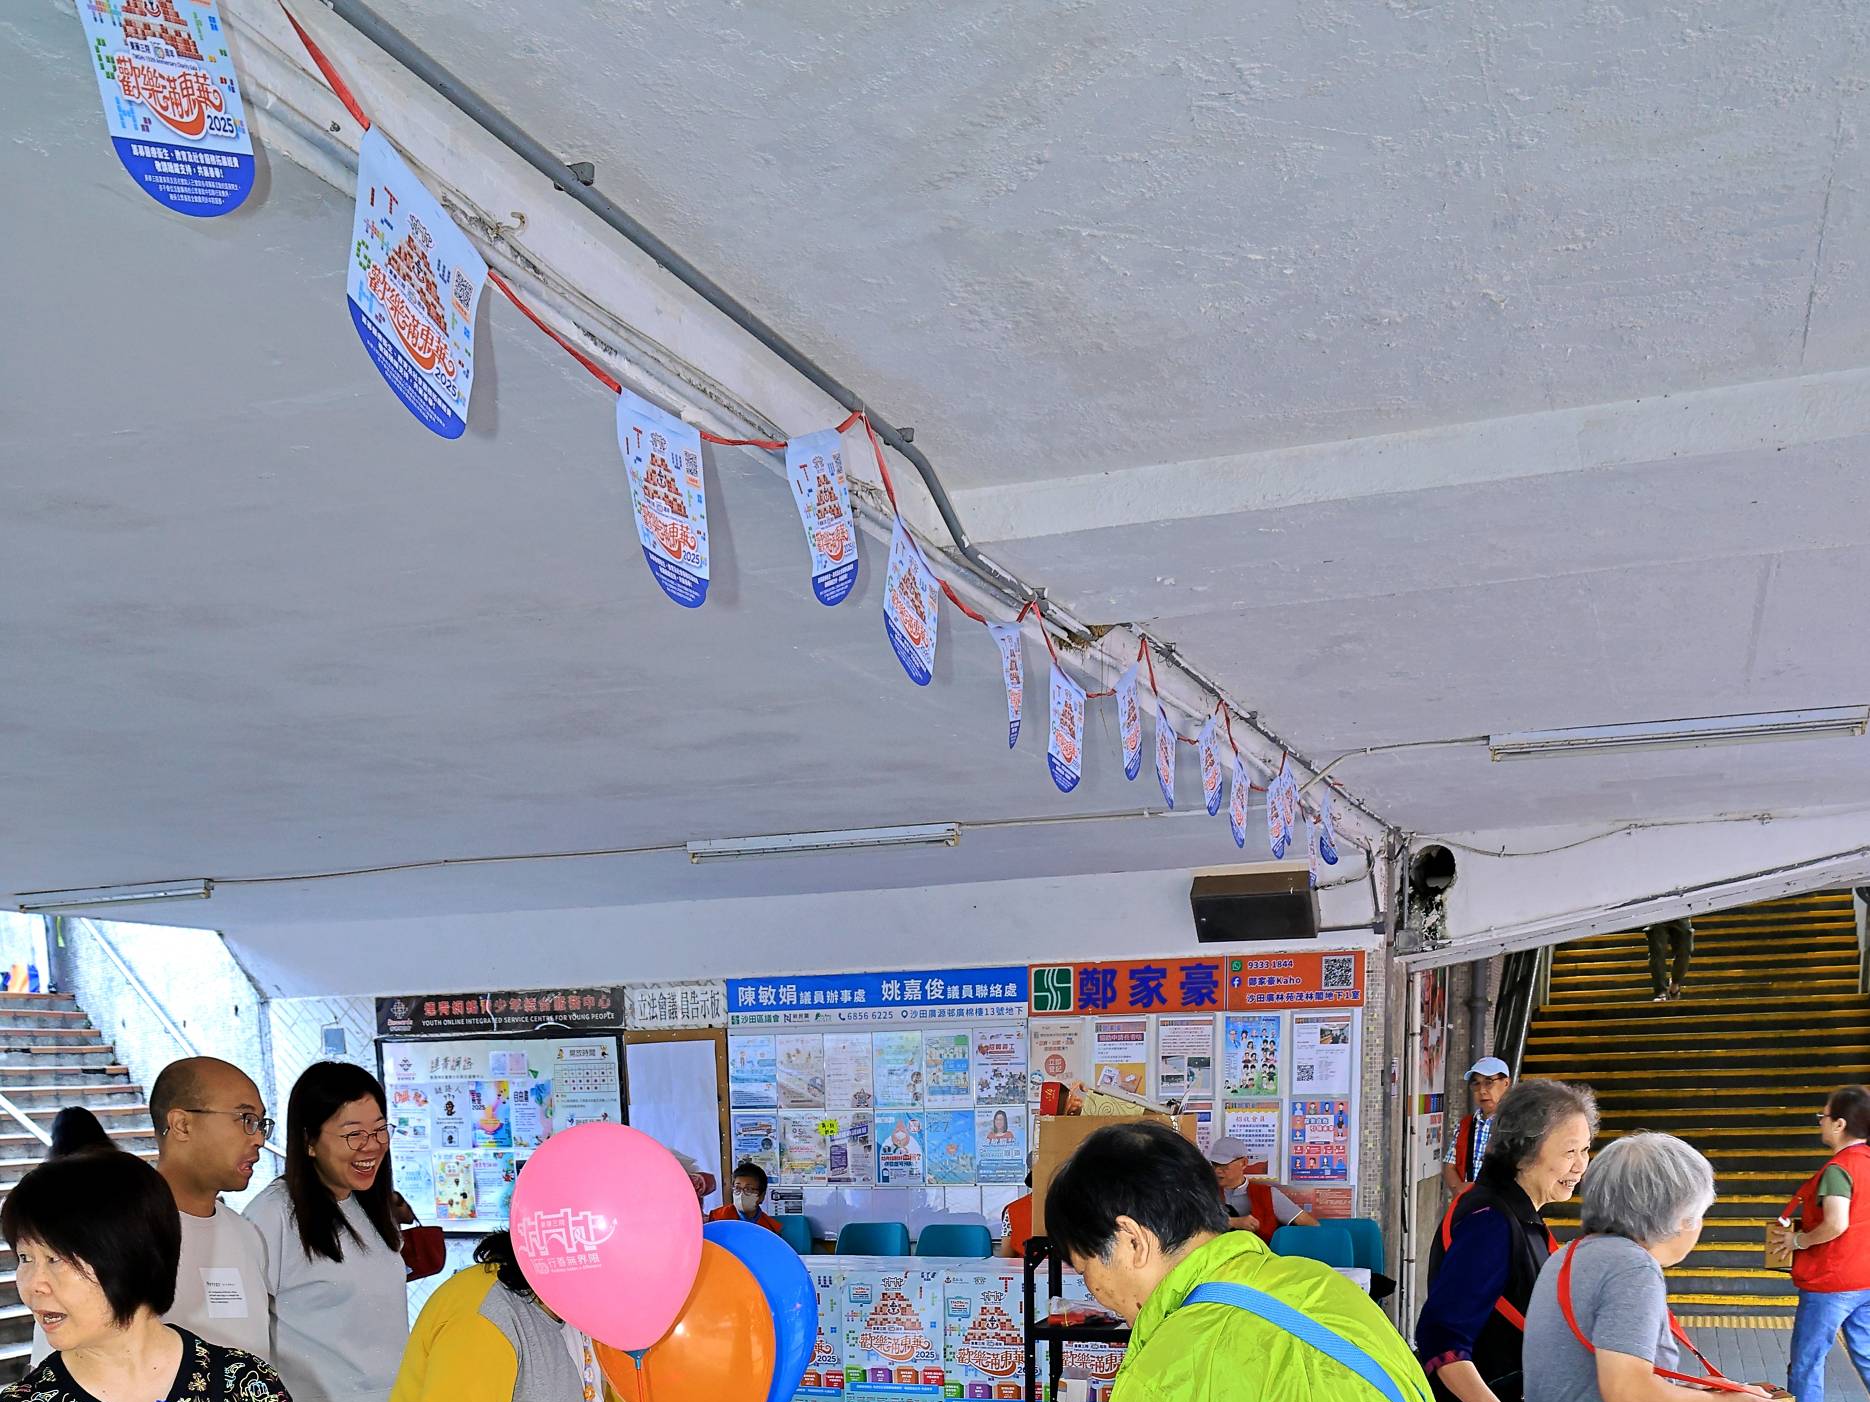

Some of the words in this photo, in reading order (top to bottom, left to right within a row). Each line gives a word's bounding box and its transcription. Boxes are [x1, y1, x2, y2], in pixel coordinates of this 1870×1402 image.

[116, 56, 223, 119] 歡樂滿東華
[207, 114, 235, 134] 2025
[368, 264, 455, 378] 歡樂滿東華
[435, 367, 459, 397] 2025
[684, 550, 700, 564] 2025
[1248, 960, 1271, 969] 9333
[1272, 959, 1293, 968] 1844
[738, 984, 866, 1007] 陳敏娟議員辦事處
[882, 978, 1017, 1001] 姚嘉俊議員聯絡處
[1078, 962, 1219, 1010] 鄭家豪
[638, 989, 720, 1020] 立法會議員告示板
[504, 1015, 529, 1023] SERVICE
[530, 1014, 554, 1022] CENTRE
[568, 1013, 590, 1021] YOUNG
[591, 1012, 614, 1020] PEOPLE
[741, 1014, 780, 1024] 沙田區議會
[848, 1012, 868, 1020] 6856
[872, 1011, 893, 1019] 6225
[817, 1354, 837, 1363] 2025
[915, 1350, 935, 1360] 2025
